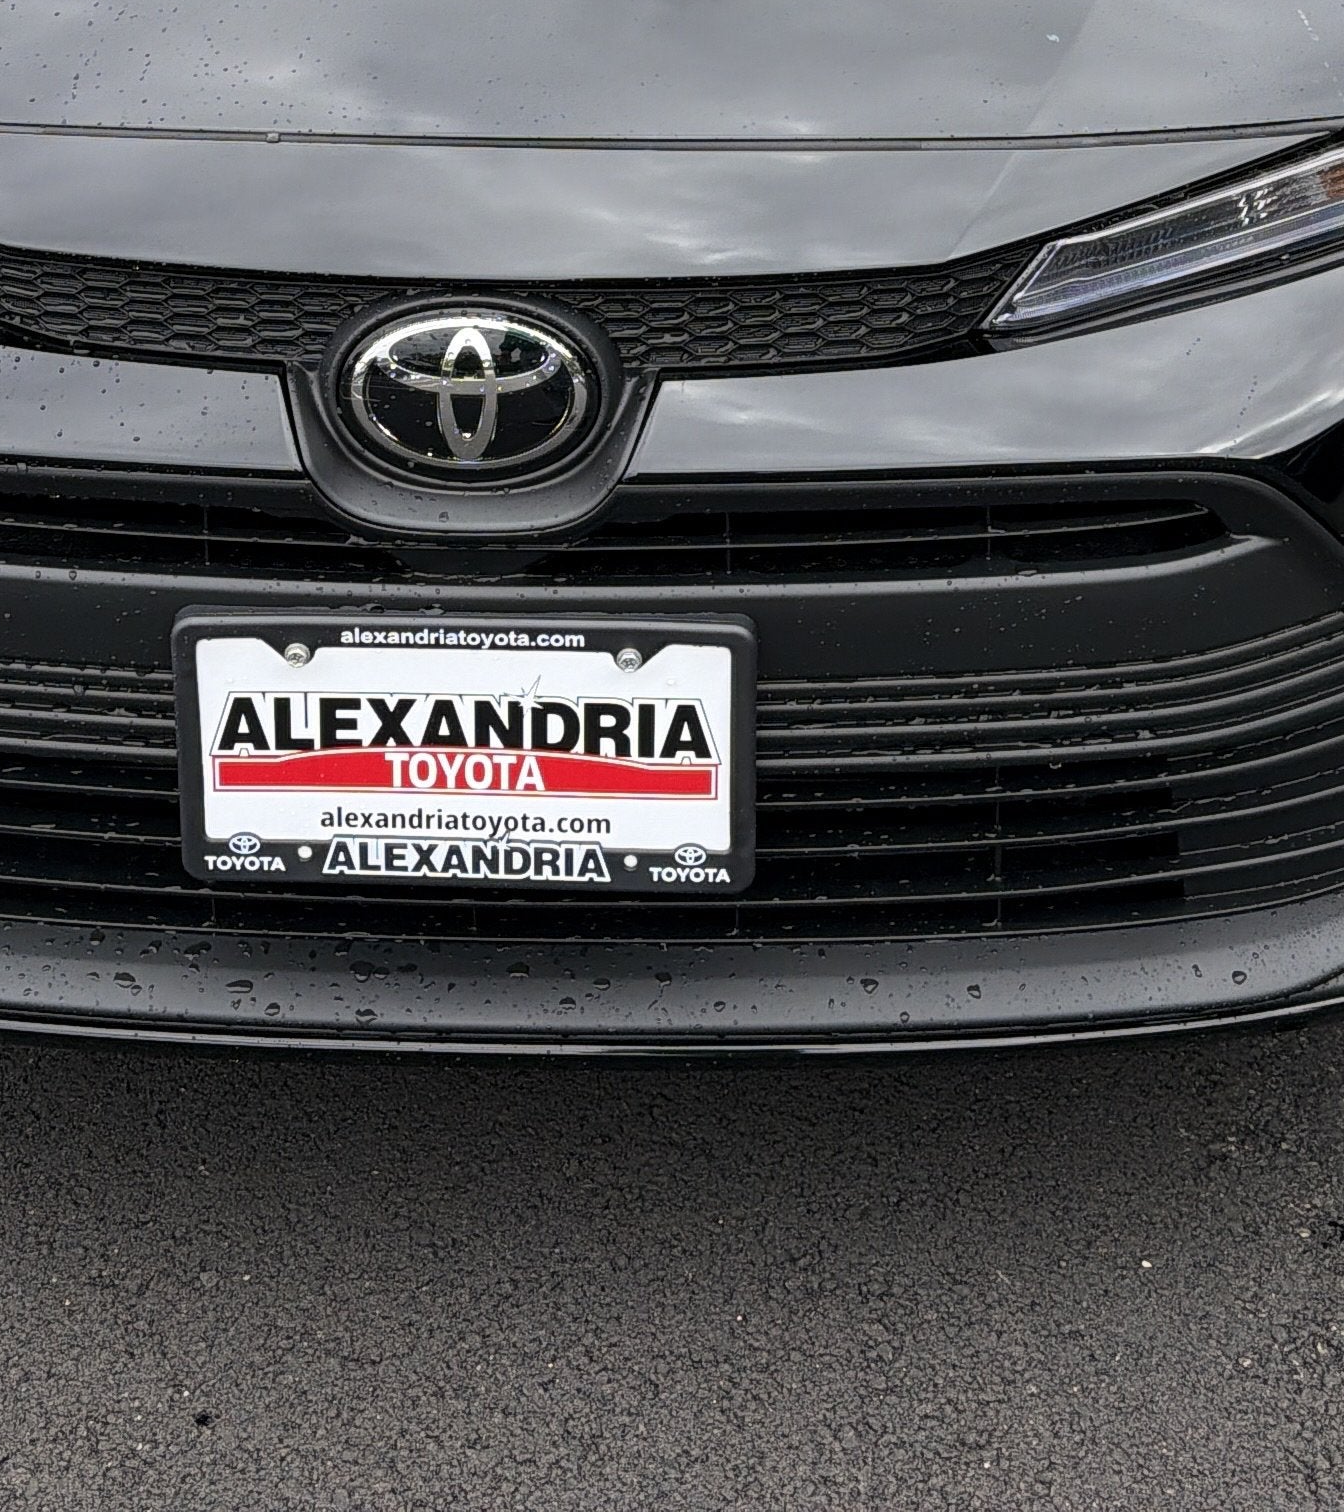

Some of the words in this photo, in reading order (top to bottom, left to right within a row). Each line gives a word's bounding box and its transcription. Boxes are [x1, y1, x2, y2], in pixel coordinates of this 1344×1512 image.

[340, 628, 585, 649] alexandriatoyota.com
[216, 694, 714, 760] ALEXANDRIA
[384, 752, 546, 791] TOYOTA
[321, 807, 612, 838] alexandriatoyota.com
[204, 855, 286, 872] TOYOTA
[324, 838, 610, 882] ALEXANDRIA
[649, 867, 731, 883] TOYOTA
